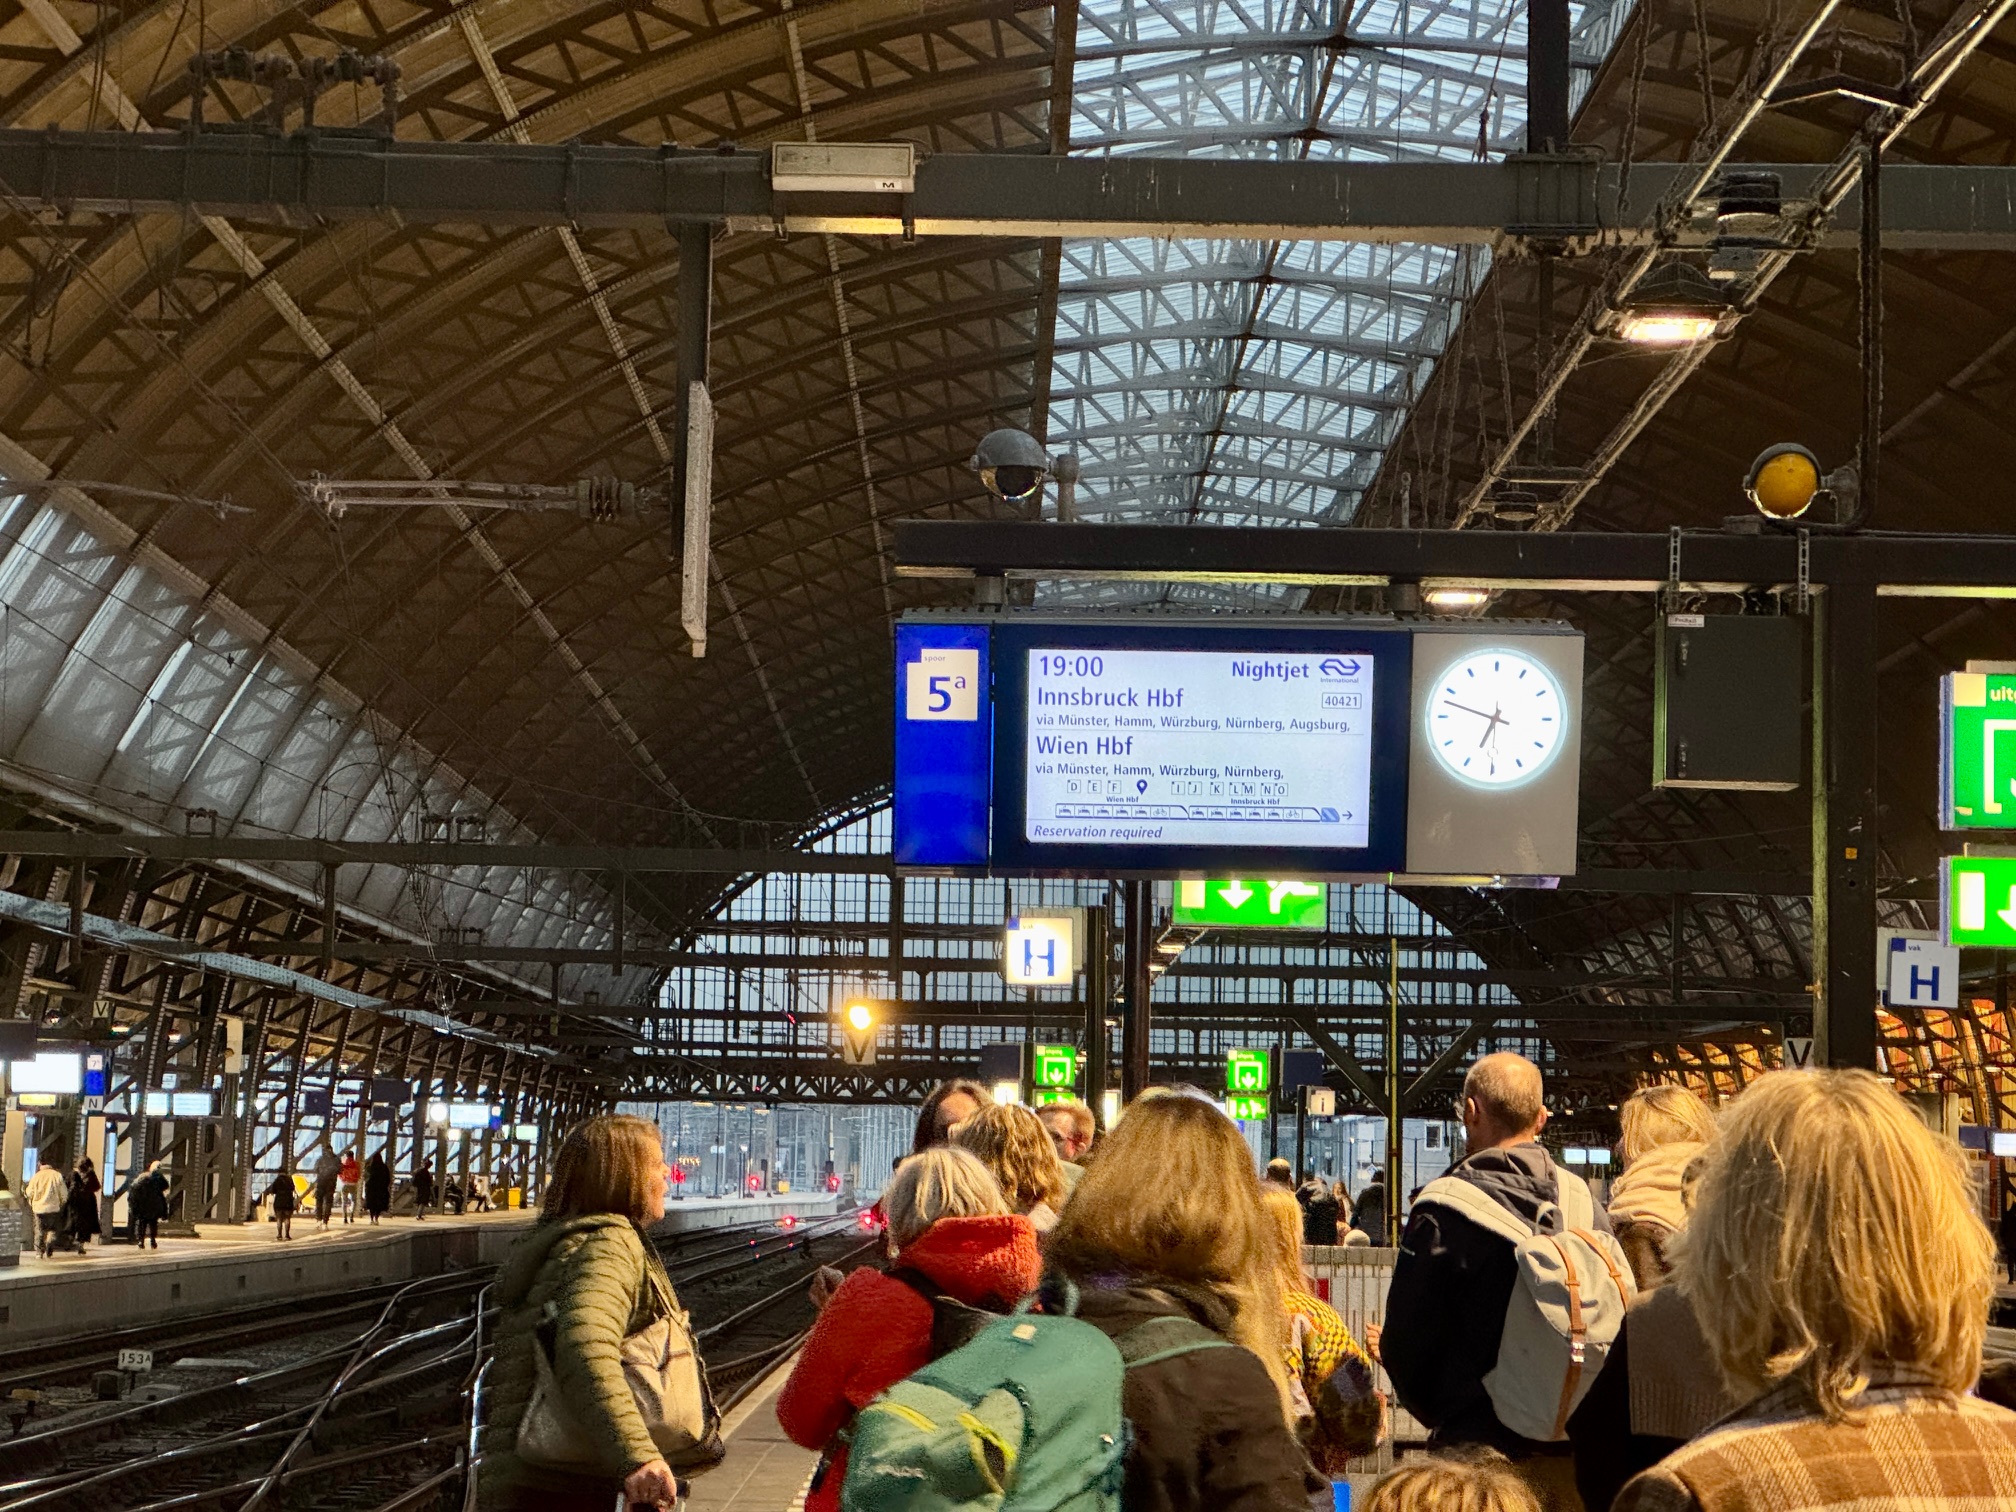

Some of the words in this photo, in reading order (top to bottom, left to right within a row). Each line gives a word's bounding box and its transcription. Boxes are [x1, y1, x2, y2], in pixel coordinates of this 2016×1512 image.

[1040, 656, 1103, 677] 19:00
[1232, 660, 1309, 682] Nightjet
[1038, 687, 1139, 706] Innsbruck
[1148, 688, 1184, 707] Hbf
[1325, 696, 1358, 707] 40421
[1037, 715, 1054, 726] via
[1058, 715, 1110, 728] Münster,
[1115, 716, 1156, 728] Hamm,
[1161, 716, 1221, 730] Würzburg,
[1226, 718, 1285, 731] Nürnberg,
[1290, 719, 1350, 732] Augsburg,
[1037, 735, 1088, 755] Wien
[1097, 736, 1133, 755] Hbf
[1036, 762, 1053, 774] via
[1058, 763, 1109, 776] Münster,
[1113, 764, 1155, 777] Hamm,
[1160, 765, 1219, 778] Würzburg,
[1225, 766, 1284, 780] Nürnberg,
[1071, 783, 1078, 791] D
[1092, 783, 1097, 791] E
[1112, 783, 1117, 792] F
[1192, 784, 1197, 793] J
[1214, 785, 1220, 793] K
[1234, 786, 1239, 794] L
[1244, 786, 1253, 794] M
[1264, 786, 1271, 794] N
[1278, 786, 1285, 795] O
[1034, 825, 1106, 838] Reservation
[1110, 827, 1163, 840] required
[1024, 939, 1054, 976] H
[1910, 964, 1939, 1001] H
[96, 1002, 107, 1016] V
[847, 1031, 871, 1062] V
[1787, 1040, 1812, 1069] V
[89, 1099, 97, 1108] N
[121, 1353, 151, 1364] 153A
